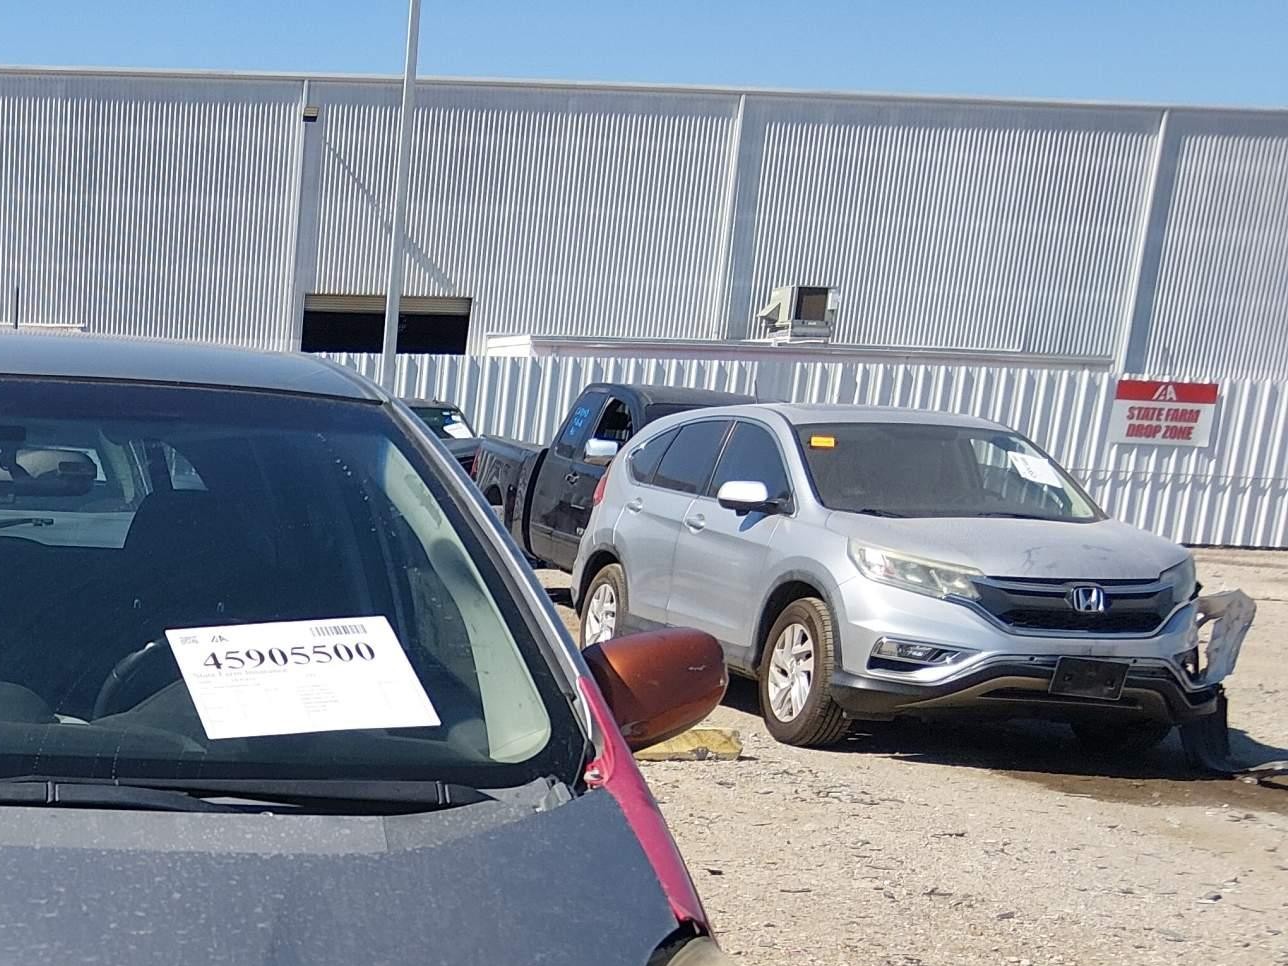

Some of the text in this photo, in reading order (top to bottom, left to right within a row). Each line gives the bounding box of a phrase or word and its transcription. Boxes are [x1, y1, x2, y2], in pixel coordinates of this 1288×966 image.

[1126, 406, 1201, 423] STATE FARM
[1125, 423, 1195, 440] DROP ZONE
[203, 641, 376, 670] 45905500
